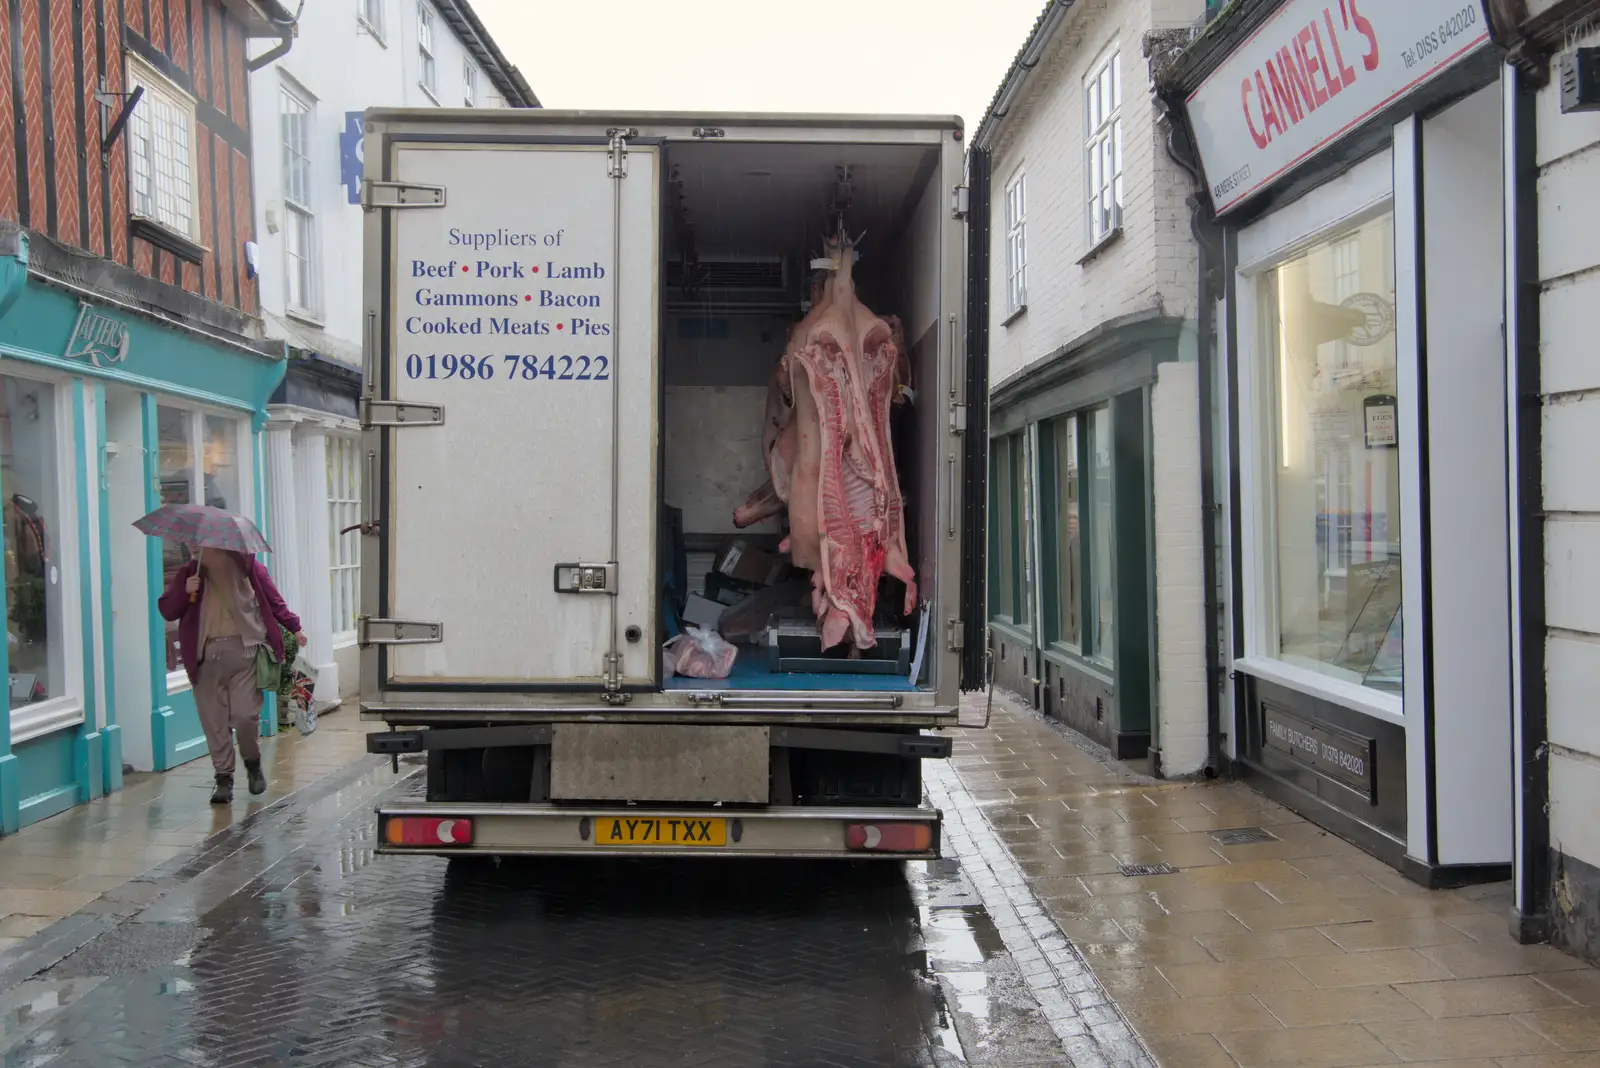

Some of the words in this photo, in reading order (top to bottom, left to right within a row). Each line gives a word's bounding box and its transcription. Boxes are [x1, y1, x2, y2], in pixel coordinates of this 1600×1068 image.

[1401, 47, 1417, 69] Tel:
[1416, 31, 1439, 60] DISS
[1439, 4, 1476, 44] 642020
[1241, 0, 1379, 150] CANNELL'S
[449, 228, 537, 250] Suppliers
[543, 229, 564, 246] of
[412, 260, 457, 277] Beef
[476, 261, 525, 278] Pork
[546, 261, 606, 279] Lamb
[415, 288, 518, 306] Gammons
[539, 289, 601, 307] Bacon
[405, 316, 482, 335] Cooked
[489, 317, 550, 335] Meats
[571, 318, 611, 336] Pies
[405, 353, 494, 380] 01986
[504, 354, 610, 381] 784222
[1288, 728, 1318, 754] BUTCHERS
[1321, 743, 1339, 764] 01379
[1339, 751, 1364, 775] 642020
[610, 819, 661, 840] AY71
[667, 820, 712, 841] TXX
